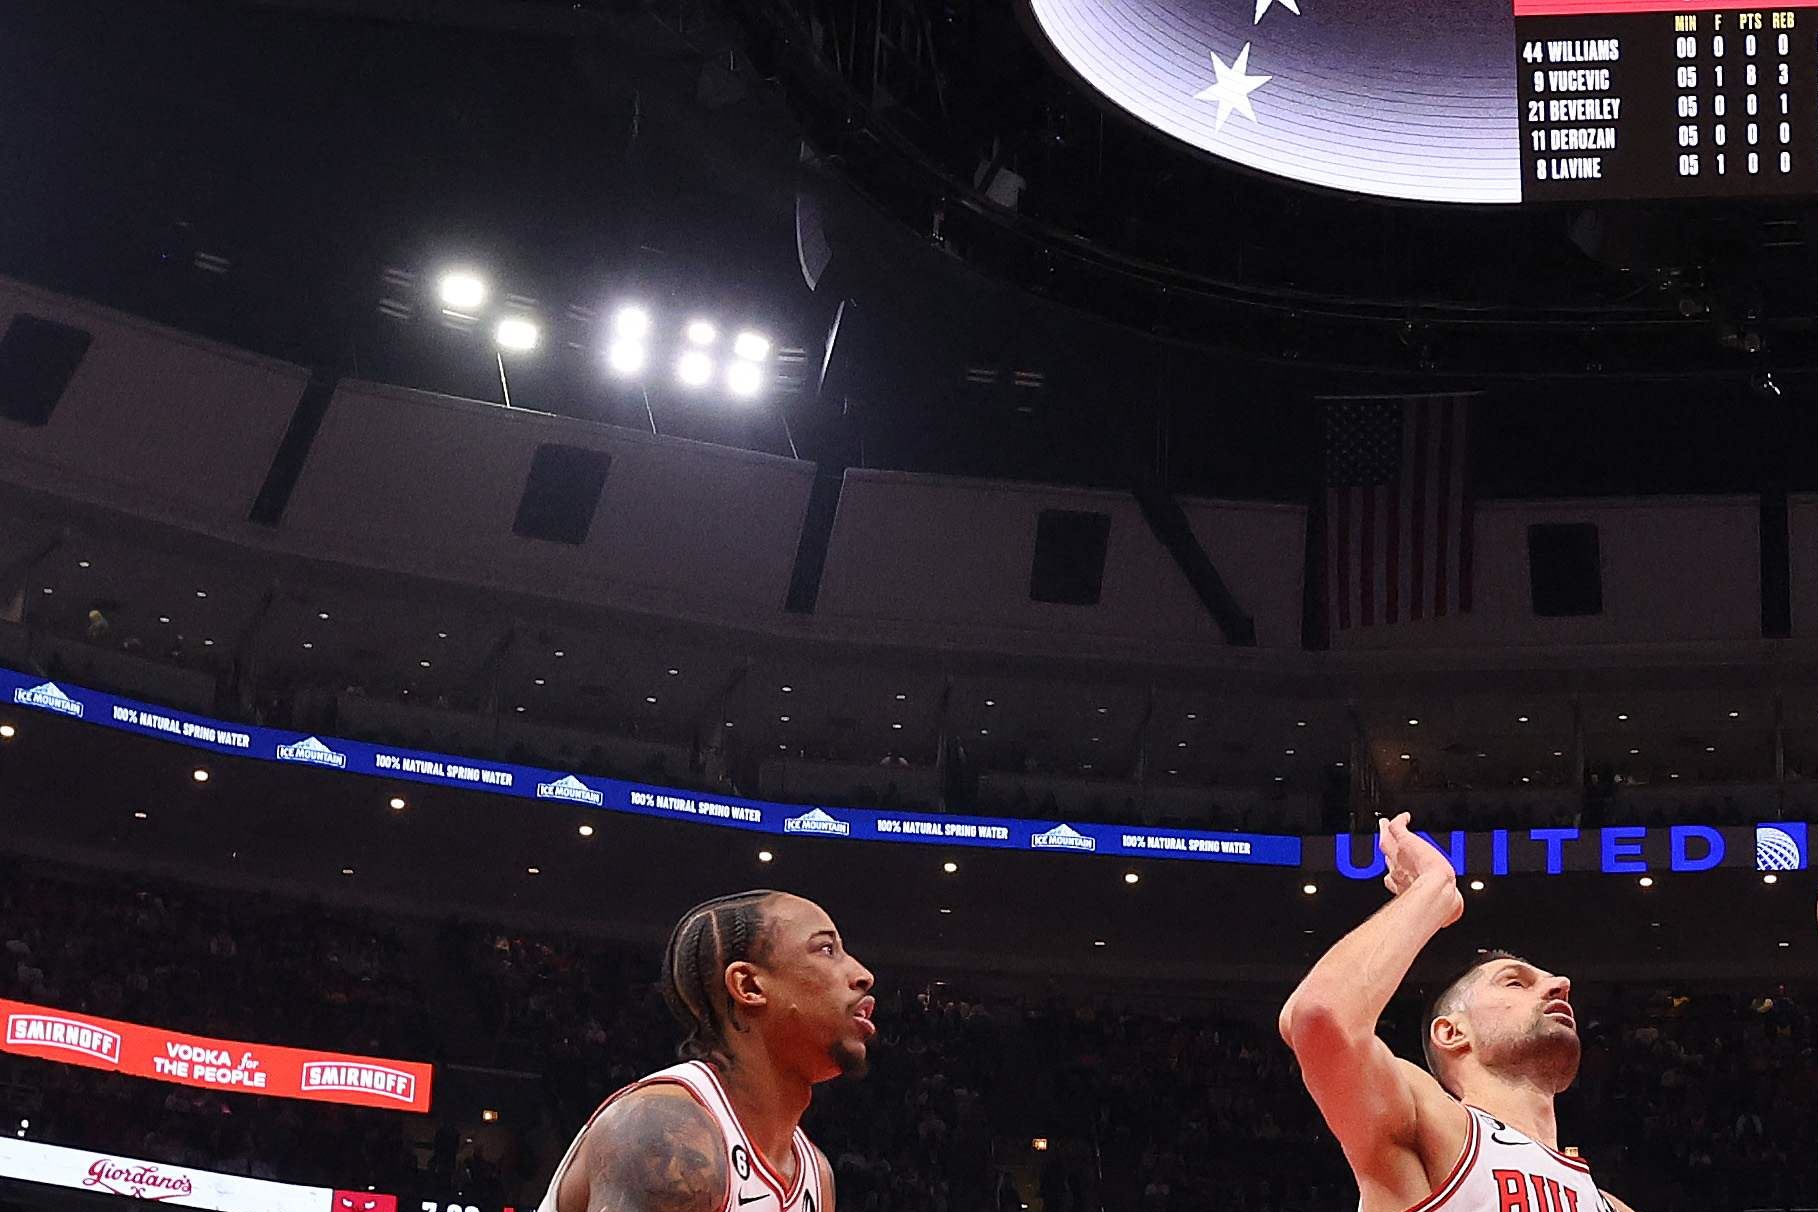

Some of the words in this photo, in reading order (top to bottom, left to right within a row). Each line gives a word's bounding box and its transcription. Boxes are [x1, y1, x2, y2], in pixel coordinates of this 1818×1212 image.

[1675, 15, 1696, 31] MIN
[1715, 14, 1722, 30] F
[1740, 13, 1762, 29] PTS
[1773, 12, 1794, 28] REB
[1523, 42, 1543, 63] 44
[1548, 39, 1619, 62] WILLIAMS
[1677, 37, 1696, 58] 00
[1714, 36, 1723, 57] 0
[1746, 35, 1756, 55] 0
[1778, 34, 1788, 55] 0
[1534, 71, 1544, 92] 9
[1549, 69, 1609, 91] VUCEVIC
[1678, 66, 1696, 87] 05
[1715, 66, 1722, 86] 1
[1747, 65, 1756, 85] 8
[1779, 64, 1788, 84] 3
[1529, 101, 1544, 121] 21
[1550, 98, 1620, 121] BEVERLEY
[1678, 96, 1697, 117] 05
[1715, 95, 1724, 115] 0
[1747, 94, 1757, 115] 0
[1780, 93, 1787, 113] 1
[1532, 130, 1545, 150] 11
[1551, 128, 1615, 150] DEROZAN
[1679, 126, 1698, 146] 05
[1716, 124, 1725, 145] 0
[1748, 124, 1757, 144] 0
[1780, 122, 1789, 143] 0
[1537, 159, 1546, 179] 8
[1552, 158, 1601, 179] LAVINE
[1680, 155, 1698, 175] 05
[1717, 154, 1724, 174] 1
[1748, 153, 1758, 173] 0
[1781, 152, 1790, 172] 0
[114, 706, 137, 723] 100%
[140, 712, 181, 734] NATURAL
[183, 723, 215, 741] SPRING
[217, 731, 249, 747] WATER
[376, 754, 400, 769] 100%
[403, 758, 444, 776] NATURAL
[447, 765, 480, 781] SPRING
[482, 770, 512, 786] WATER
[631, 792, 654, 806] 100%
[657, 796, 696, 813] NATURAL
[699, 802, 730, 817] SPRING
[732, 807, 761, 822] WATER
[786, 819, 802, 829] ICE
[802, 820, 847, 834] MOUNTAIN
[878, 820, 901, 832] 100%
[903, 822, 943, 835] NATURAL
[945, 824, 976, 837] SPRING
[978, 826, 1008, 839] WATER
[1034, 835, 1049, 846] ICE
[1049, 835, 1092, 849] MOUNTAIN
[1123, 835, 1145, 847] 100%
[1148, 837, 1187, 850] NATURAL
[1189, 840, 1219, 852] SPRING
[1221, 841, 1250, 854] WATER
[15, 1019, 113, 1055] SMIRNOFF
[166, 1041, 231, 1067] VODKA
[237, 1052, 260, 1071] for
[153, 1056, 188, 1078] THE
[192, 1063, 266, 1089] PEOPLE
[309, 1067, 409, 1096] SMIRNOFF
[82, 1158, 193, 1200] Giordano's
